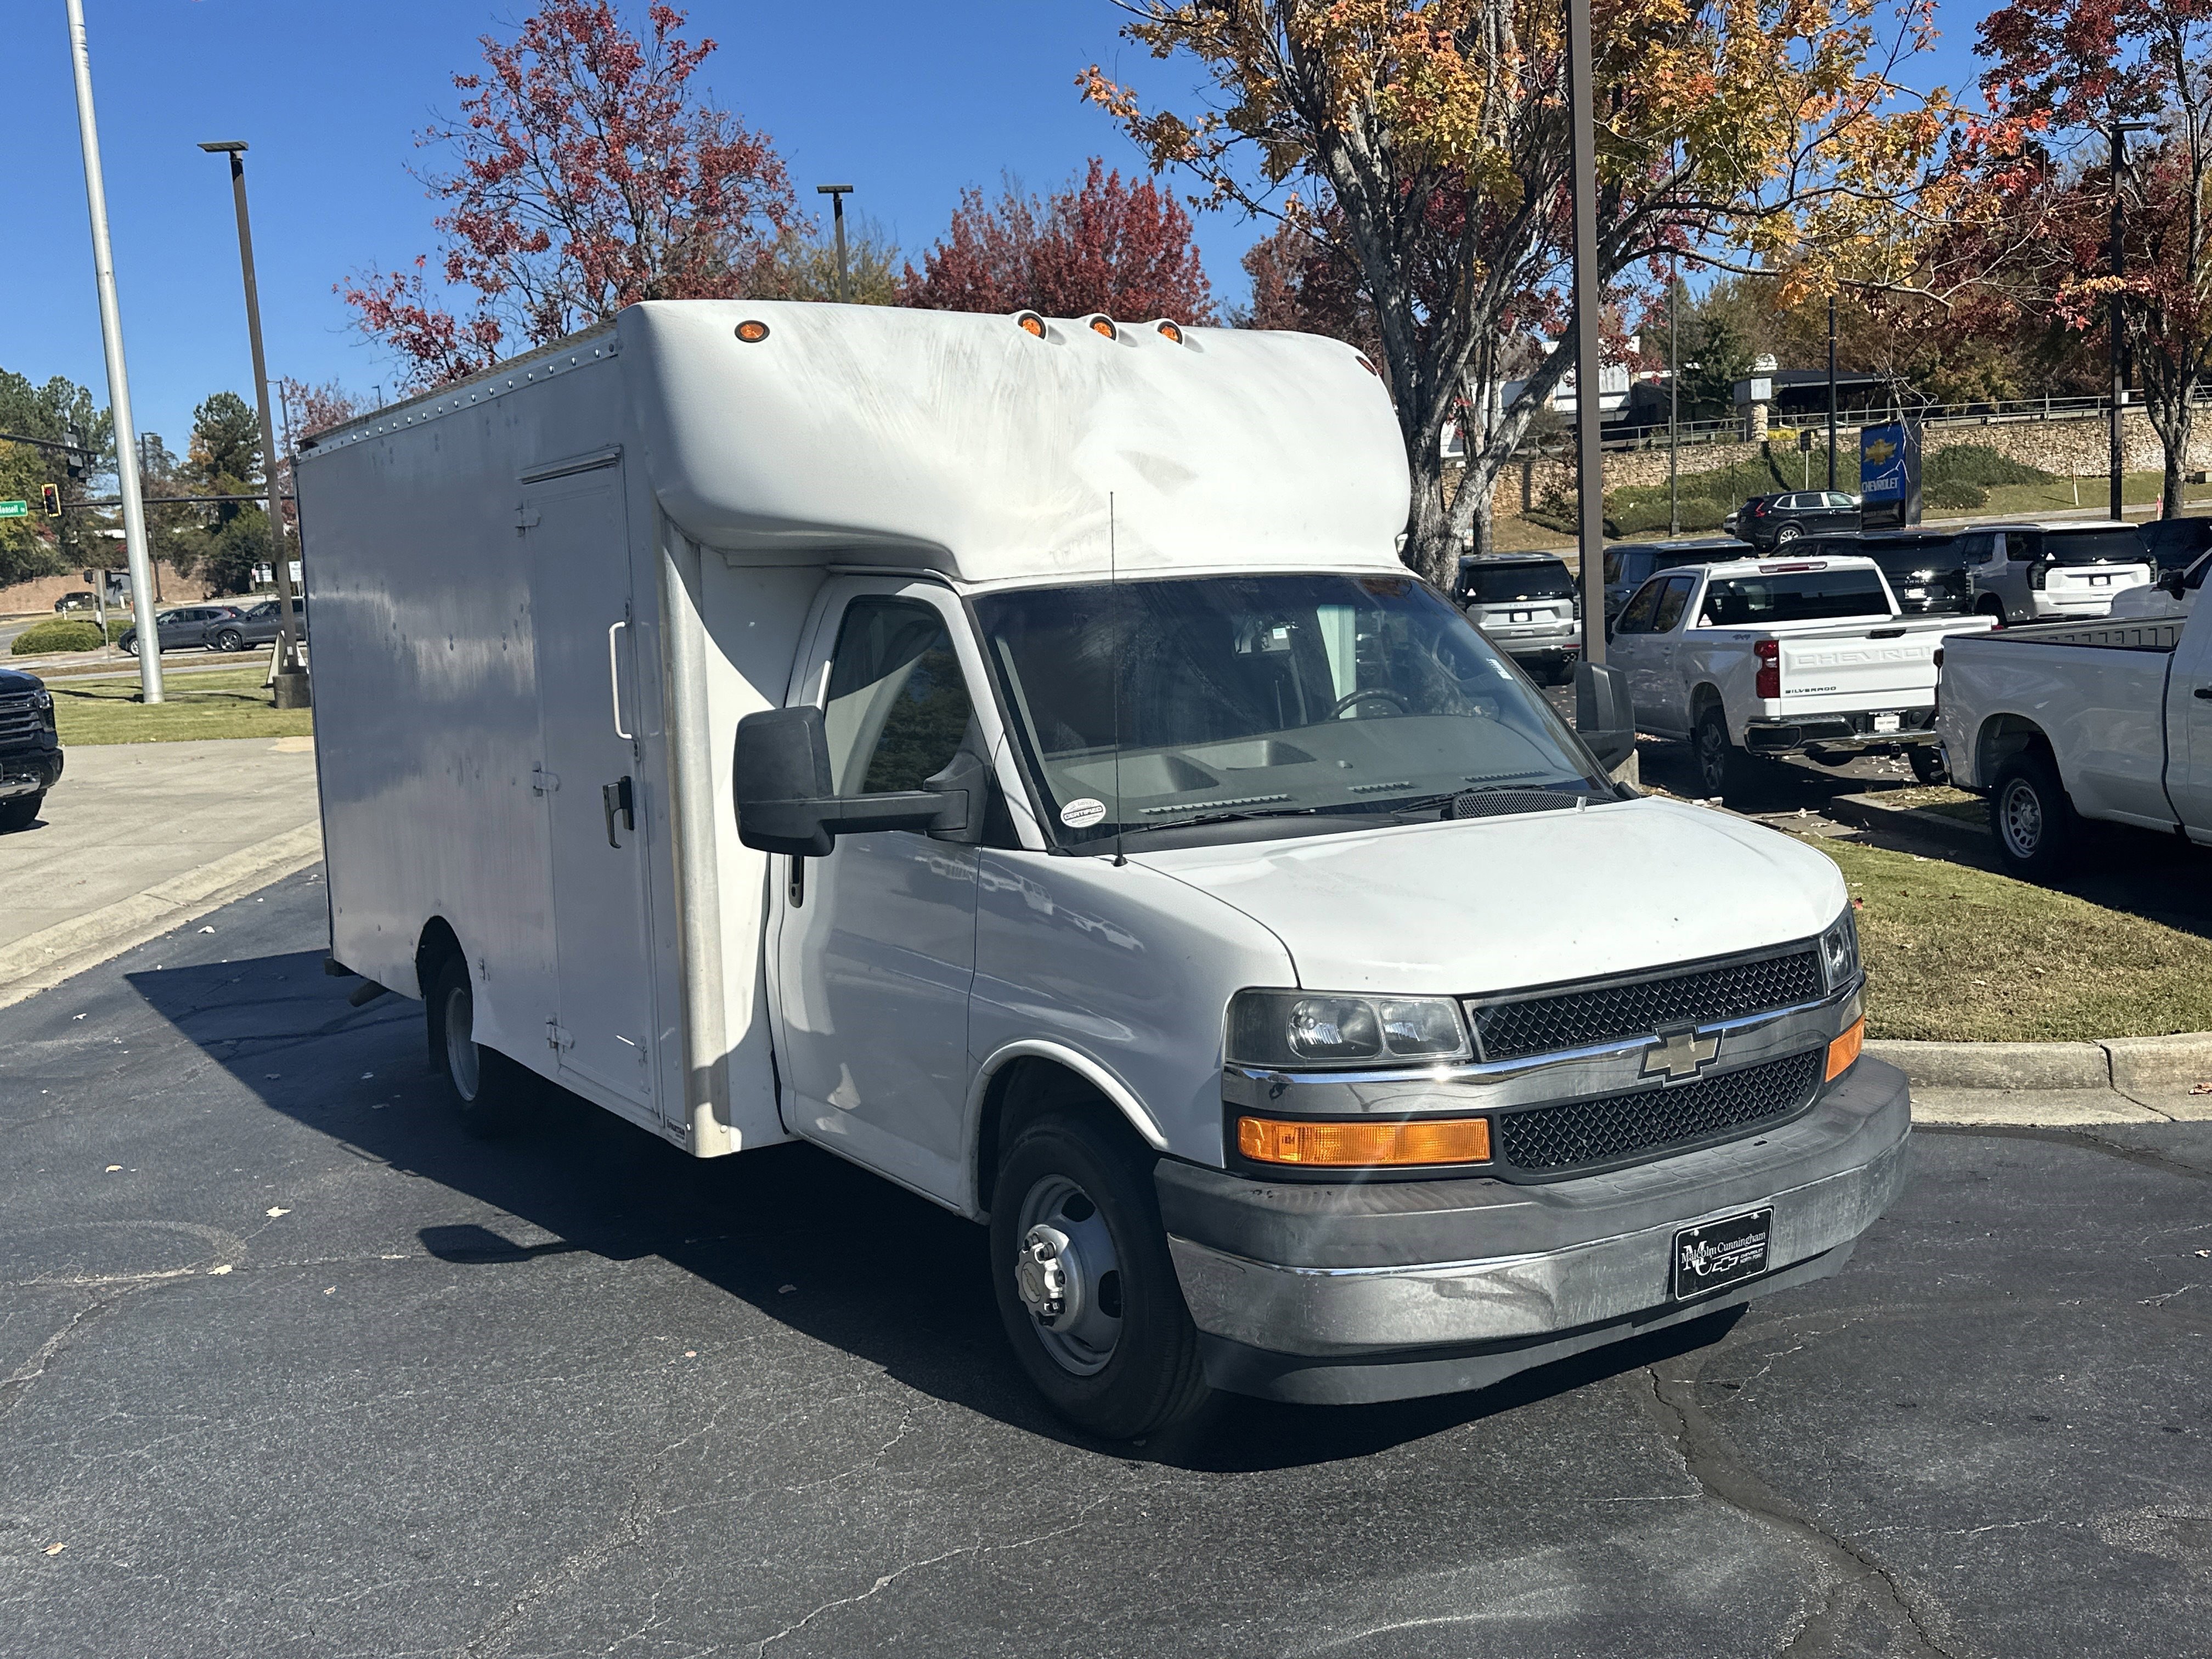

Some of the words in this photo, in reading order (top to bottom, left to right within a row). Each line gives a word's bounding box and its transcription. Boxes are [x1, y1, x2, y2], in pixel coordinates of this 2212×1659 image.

[1861, 477, 1898, 493] CHEVROLET
[1064, 806, 1103, 820] CERTIFIED
[1681, 1246, 1717, 1263] Malcolm
[1718, 1232, 1766, 1252] Cunningham
[1740, 1248, 1764, 1258] CHEVROLET
